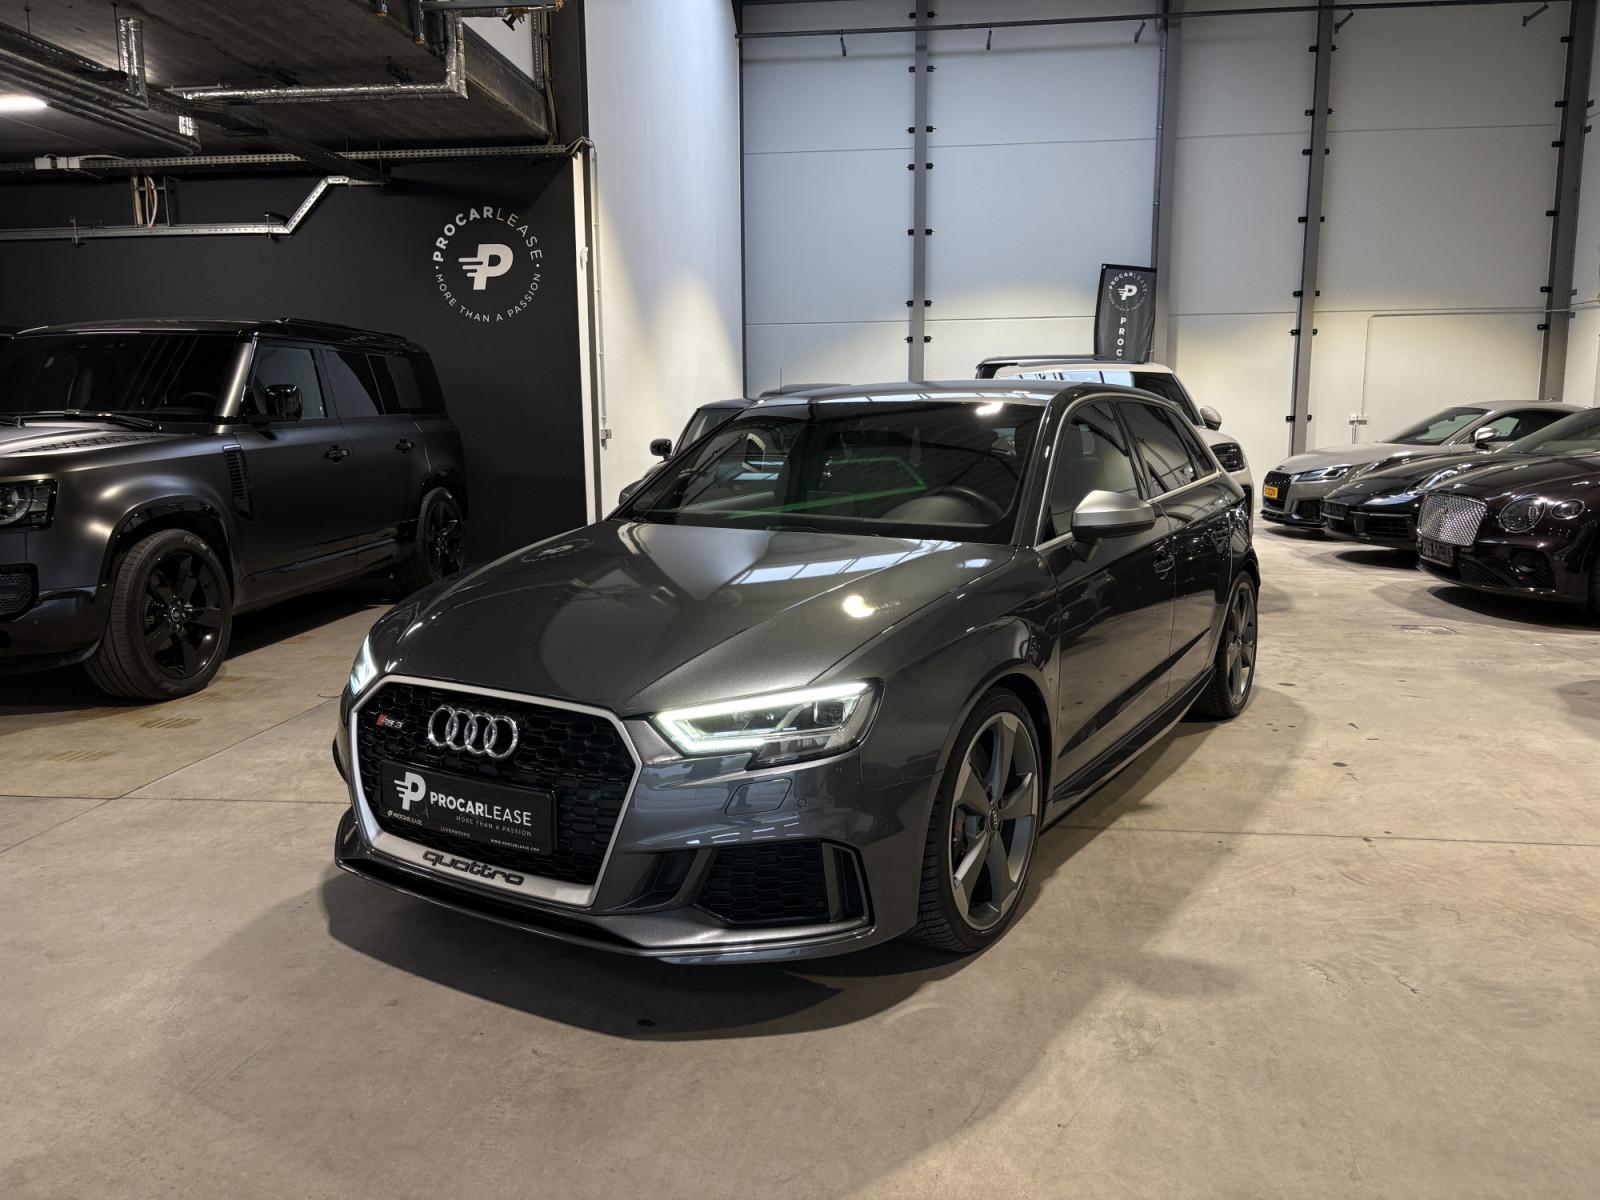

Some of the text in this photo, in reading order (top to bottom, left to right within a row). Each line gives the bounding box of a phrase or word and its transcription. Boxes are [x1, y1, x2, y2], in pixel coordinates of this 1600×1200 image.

[433, 206, 542, 263] PROCARLEASE
[435, 273, 541, 323] MORE THAN A PASSION
[430, 791, 532, 826] PROCARLEASE
[456, 815, 474, 825] MORE
[476, 820, 493, 830] THAN
[502, 825, 532, 837] PASSION
[422, 850, 525, 886] quattro
